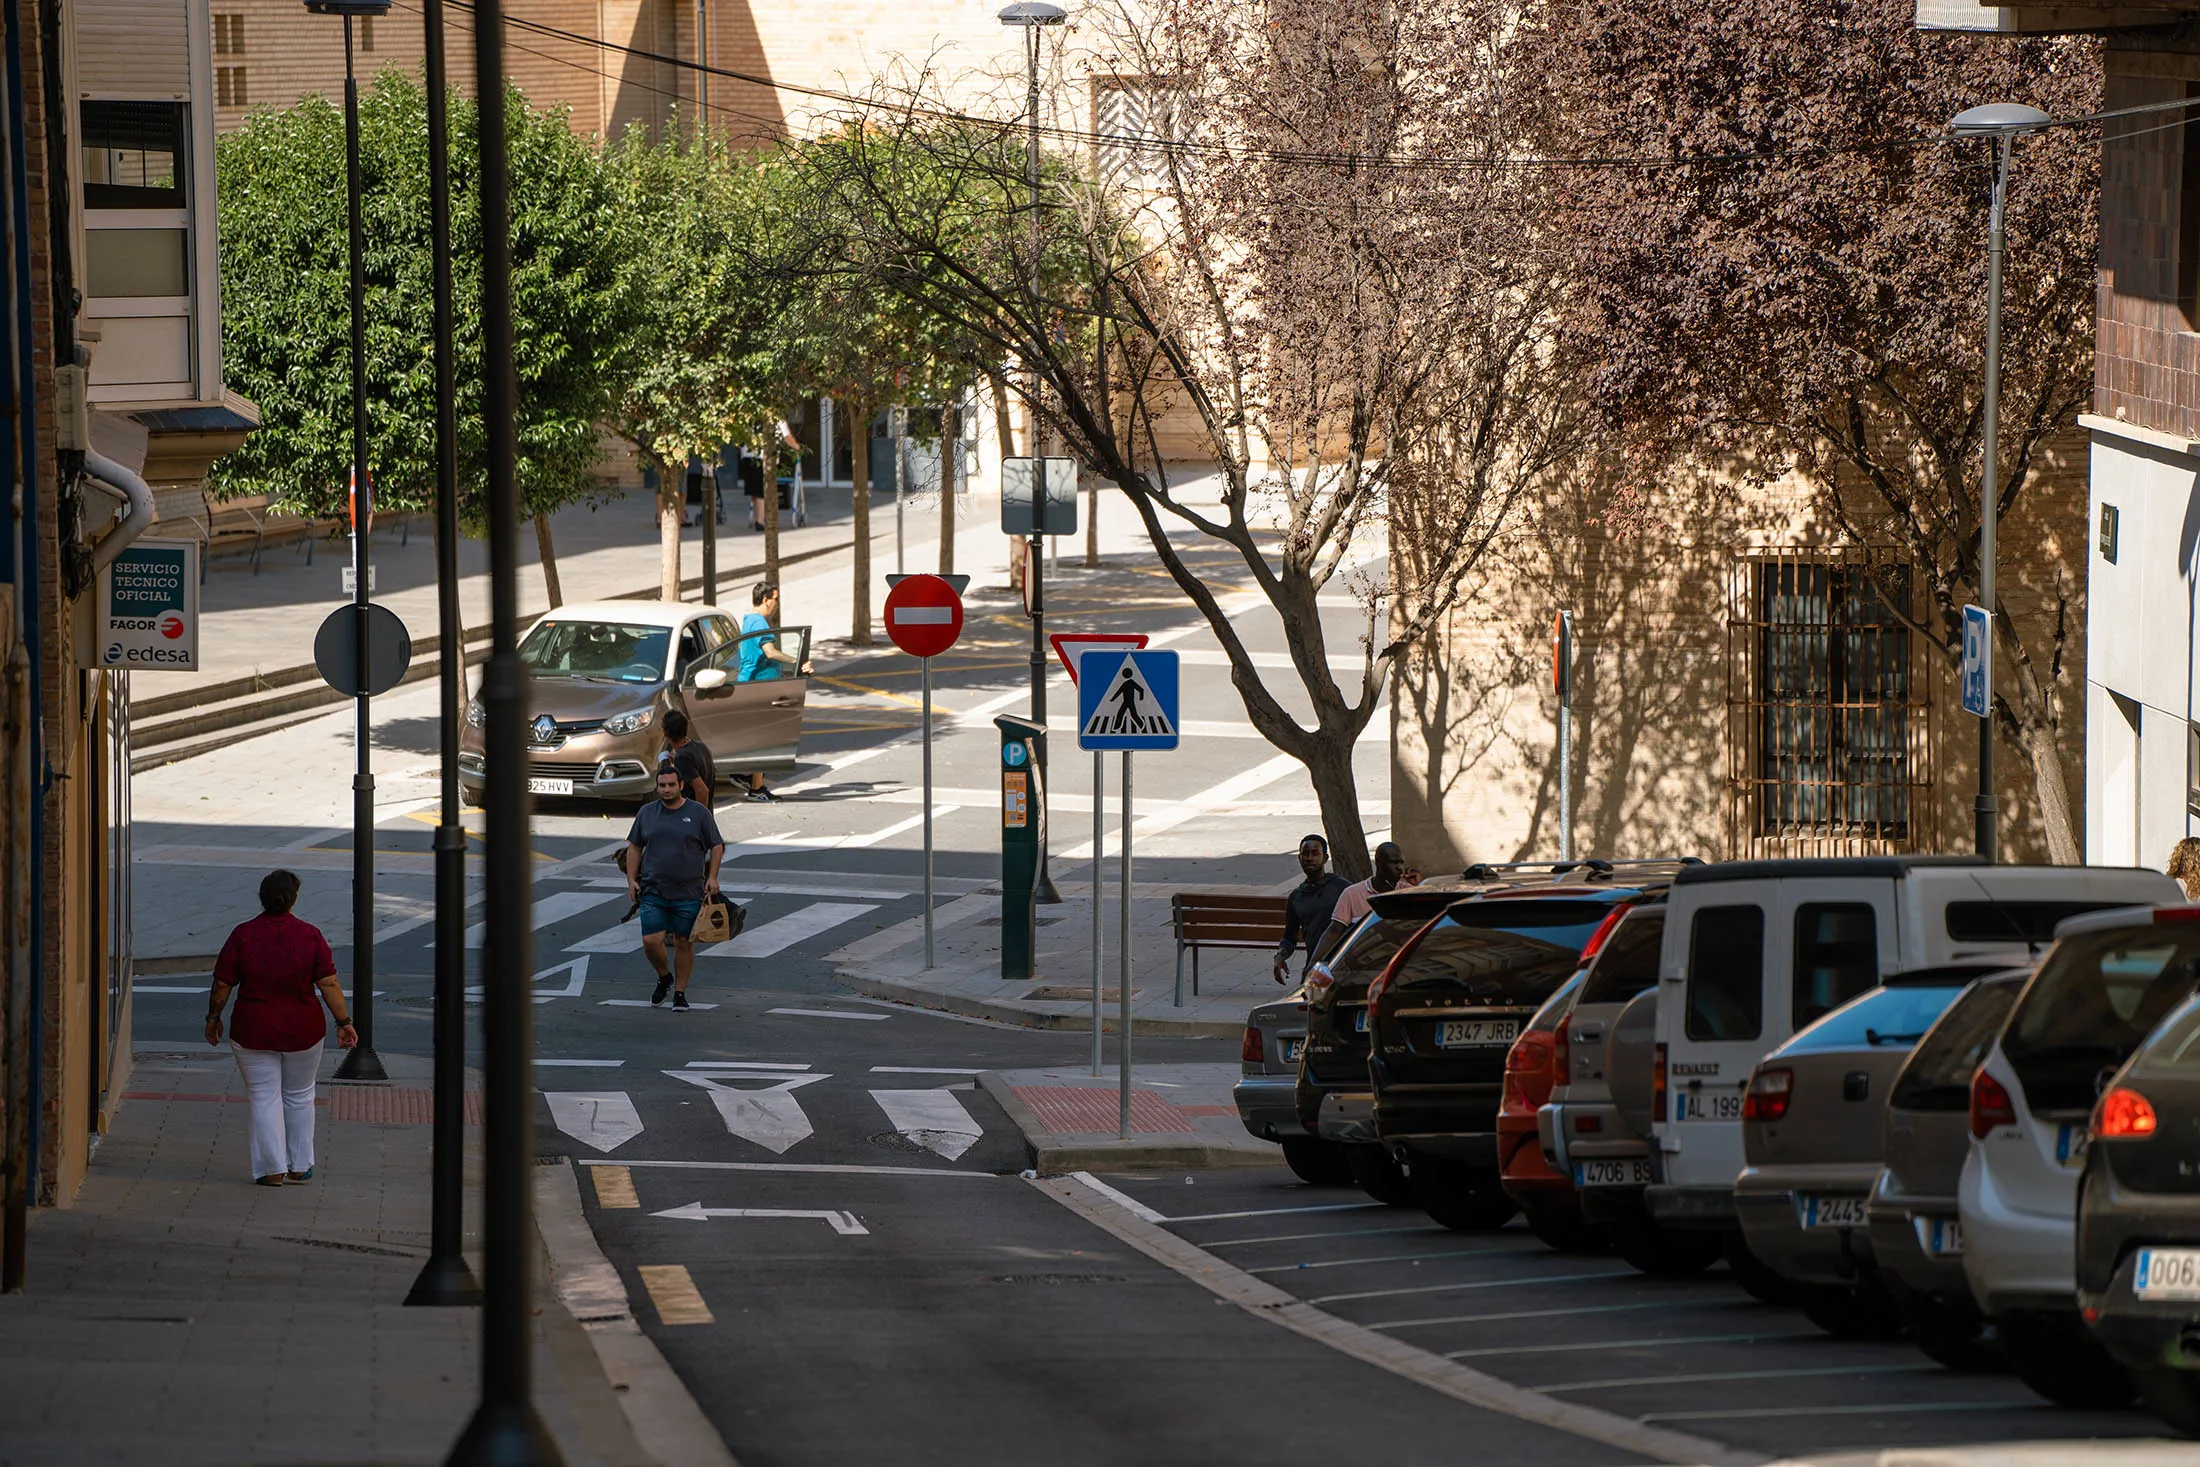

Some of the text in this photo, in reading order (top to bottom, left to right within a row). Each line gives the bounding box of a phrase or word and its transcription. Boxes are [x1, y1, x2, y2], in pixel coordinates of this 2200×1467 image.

[115, 563, 180, 575] SERVICIO
[115, 577, 178, 588] TECNICO
[115, 590, 171, 601] OFICIAL
[110, 620, 156, 630] FAGOR
[127, 646, 190, 663] edesa
[1010, 743, 1023, 765] P
[548, 782, 570, 792] HVV
[1425, 997, 1513, 1007] VOLVO
[1445, 1022, 1515, 1042] 2347 JRB
[1687, 1097, 1744, 1118] AL 199
[1586, 1162, 1624, 1182] 4706
[1821, 1200, 1864, 1224] 2445
[2151, 1256, 2200, 1288] 006
